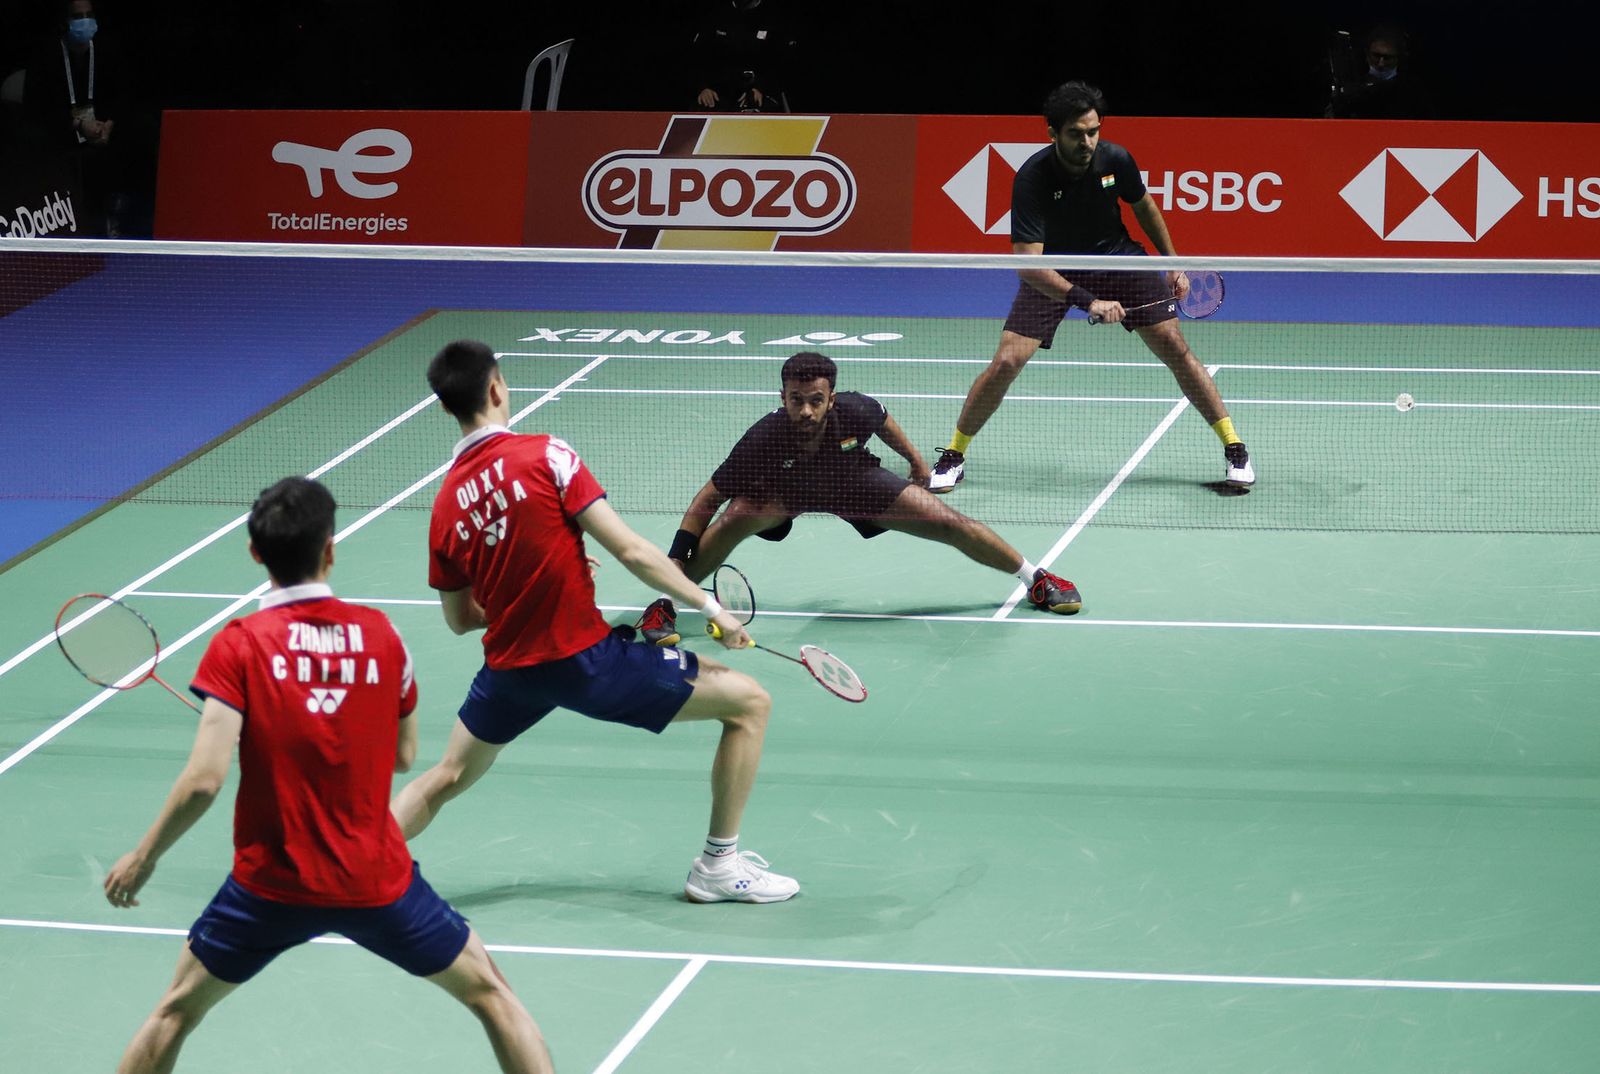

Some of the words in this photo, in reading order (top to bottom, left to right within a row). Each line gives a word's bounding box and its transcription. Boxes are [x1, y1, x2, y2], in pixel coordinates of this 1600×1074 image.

[1140, 170, 1283, 213] HSBC
[1538, 176, 1600, 219] HS
[267, 212, 408, 236] TotalEnergies
[516, 327, 746, 345] YONEX
[456, 480, 528, 541] CHINA
[288, 622, 346, 654] ZHANG
[347, 623, 364, 653] N
[272, 655, 379, 684] CHINA
